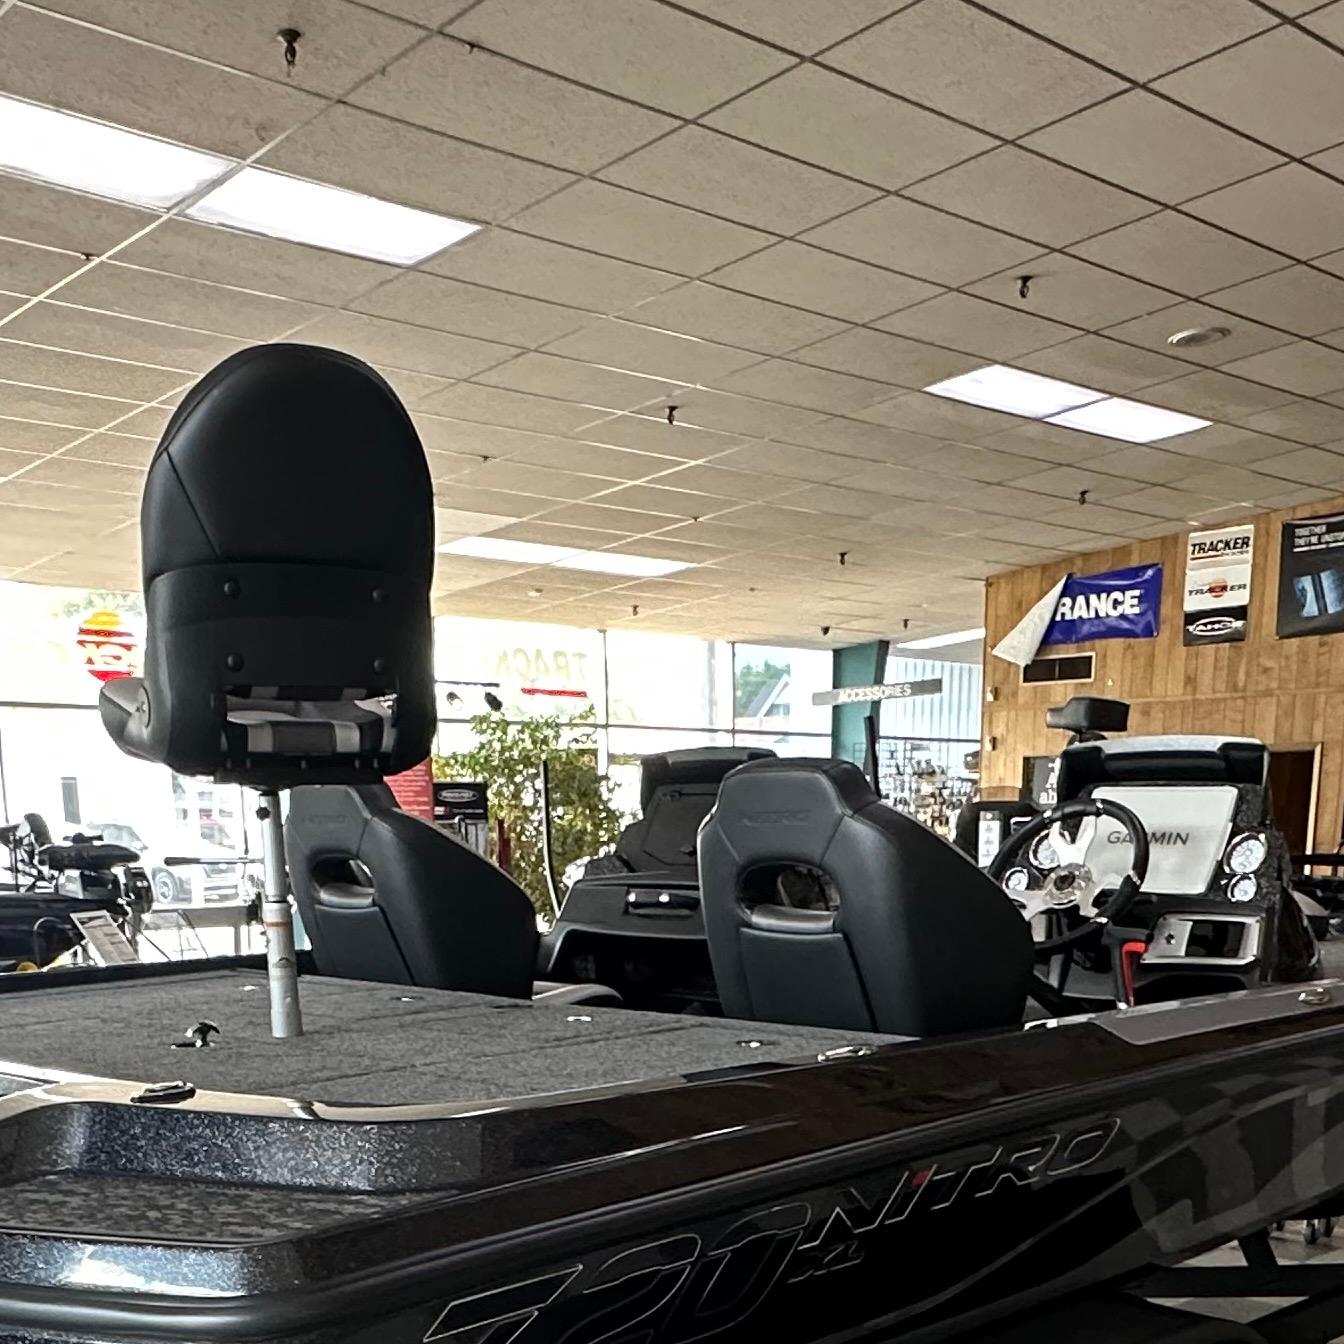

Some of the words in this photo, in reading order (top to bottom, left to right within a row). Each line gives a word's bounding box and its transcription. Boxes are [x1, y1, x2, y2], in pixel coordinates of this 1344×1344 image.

[1189, 536, 1252, 556] TRACKER
[1187, 583, 1248, 598] TRACKER
[836, 683, 912, 703] ACCESSORIES
[1106, 830, 1191, 847] GAMIN
